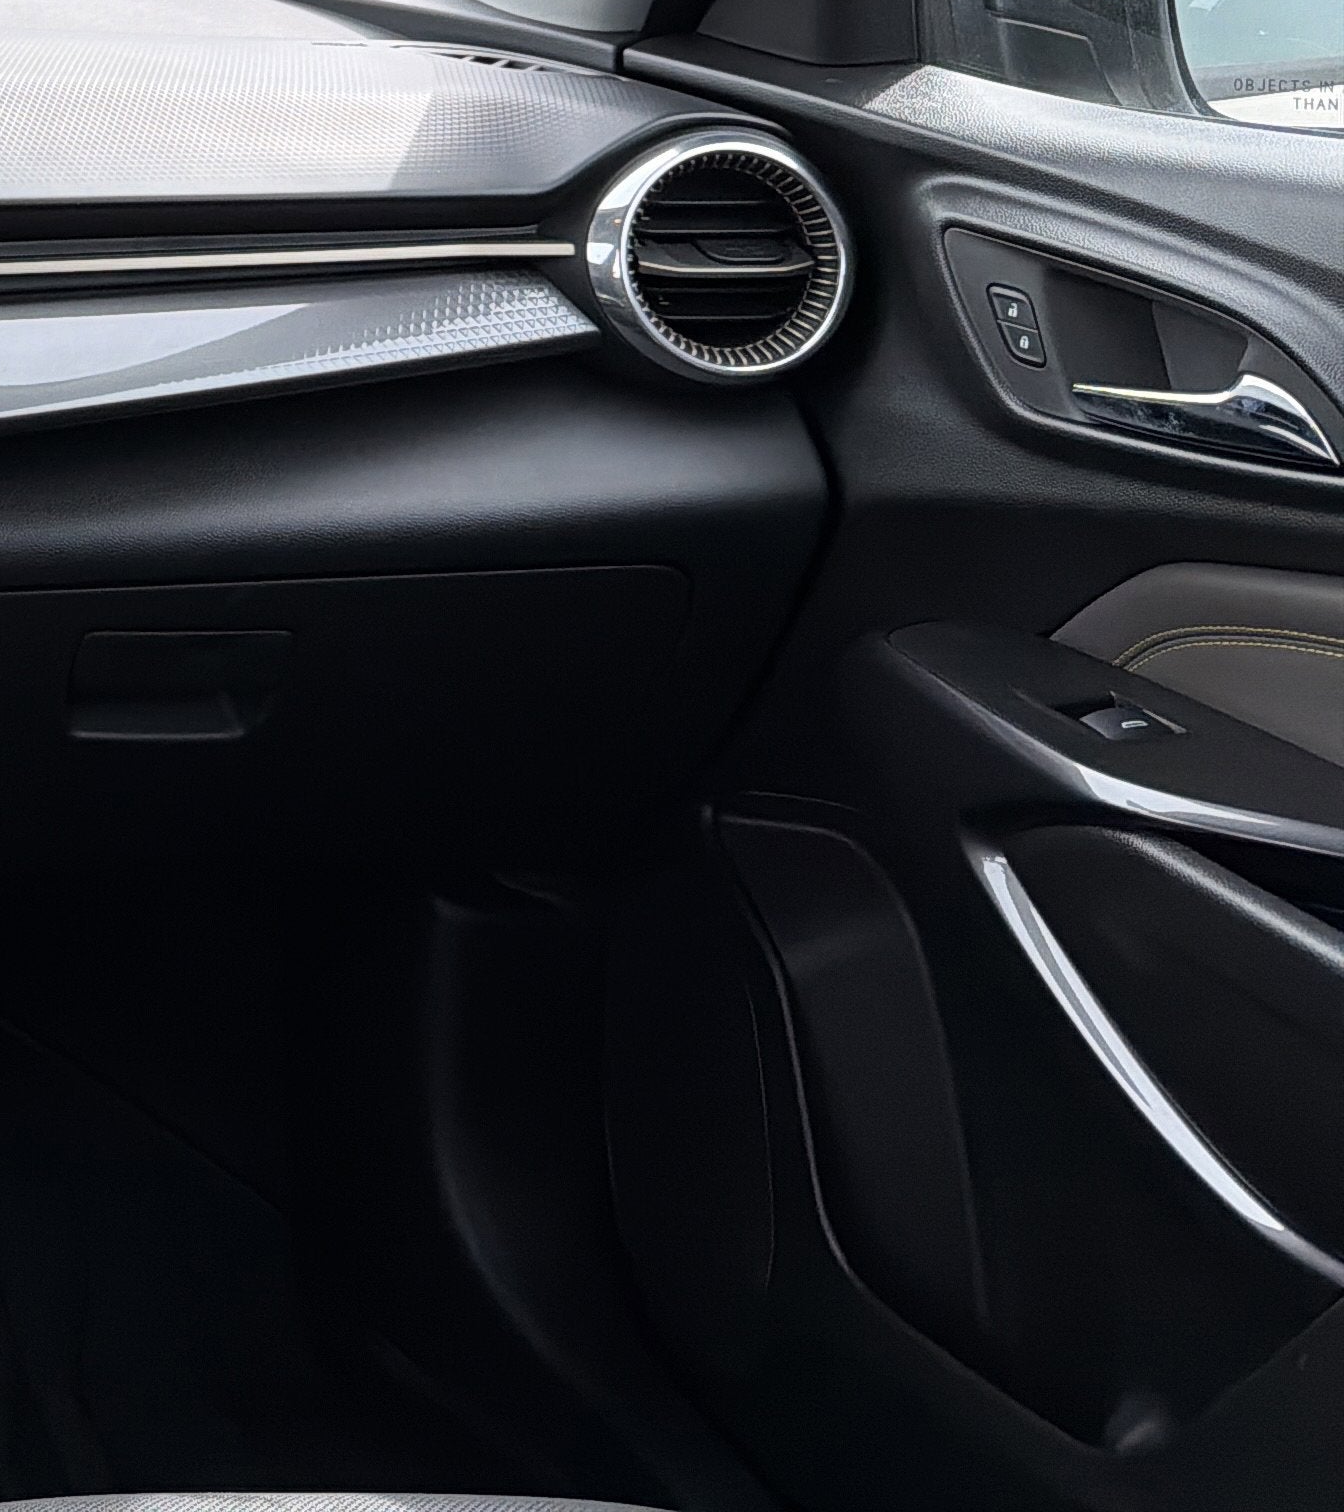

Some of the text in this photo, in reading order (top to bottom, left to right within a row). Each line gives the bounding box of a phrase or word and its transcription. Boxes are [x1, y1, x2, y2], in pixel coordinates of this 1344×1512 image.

[1233, 78, 1335, 94] OBJECTS IN
[1292, 97, 1339, 111] THAN
